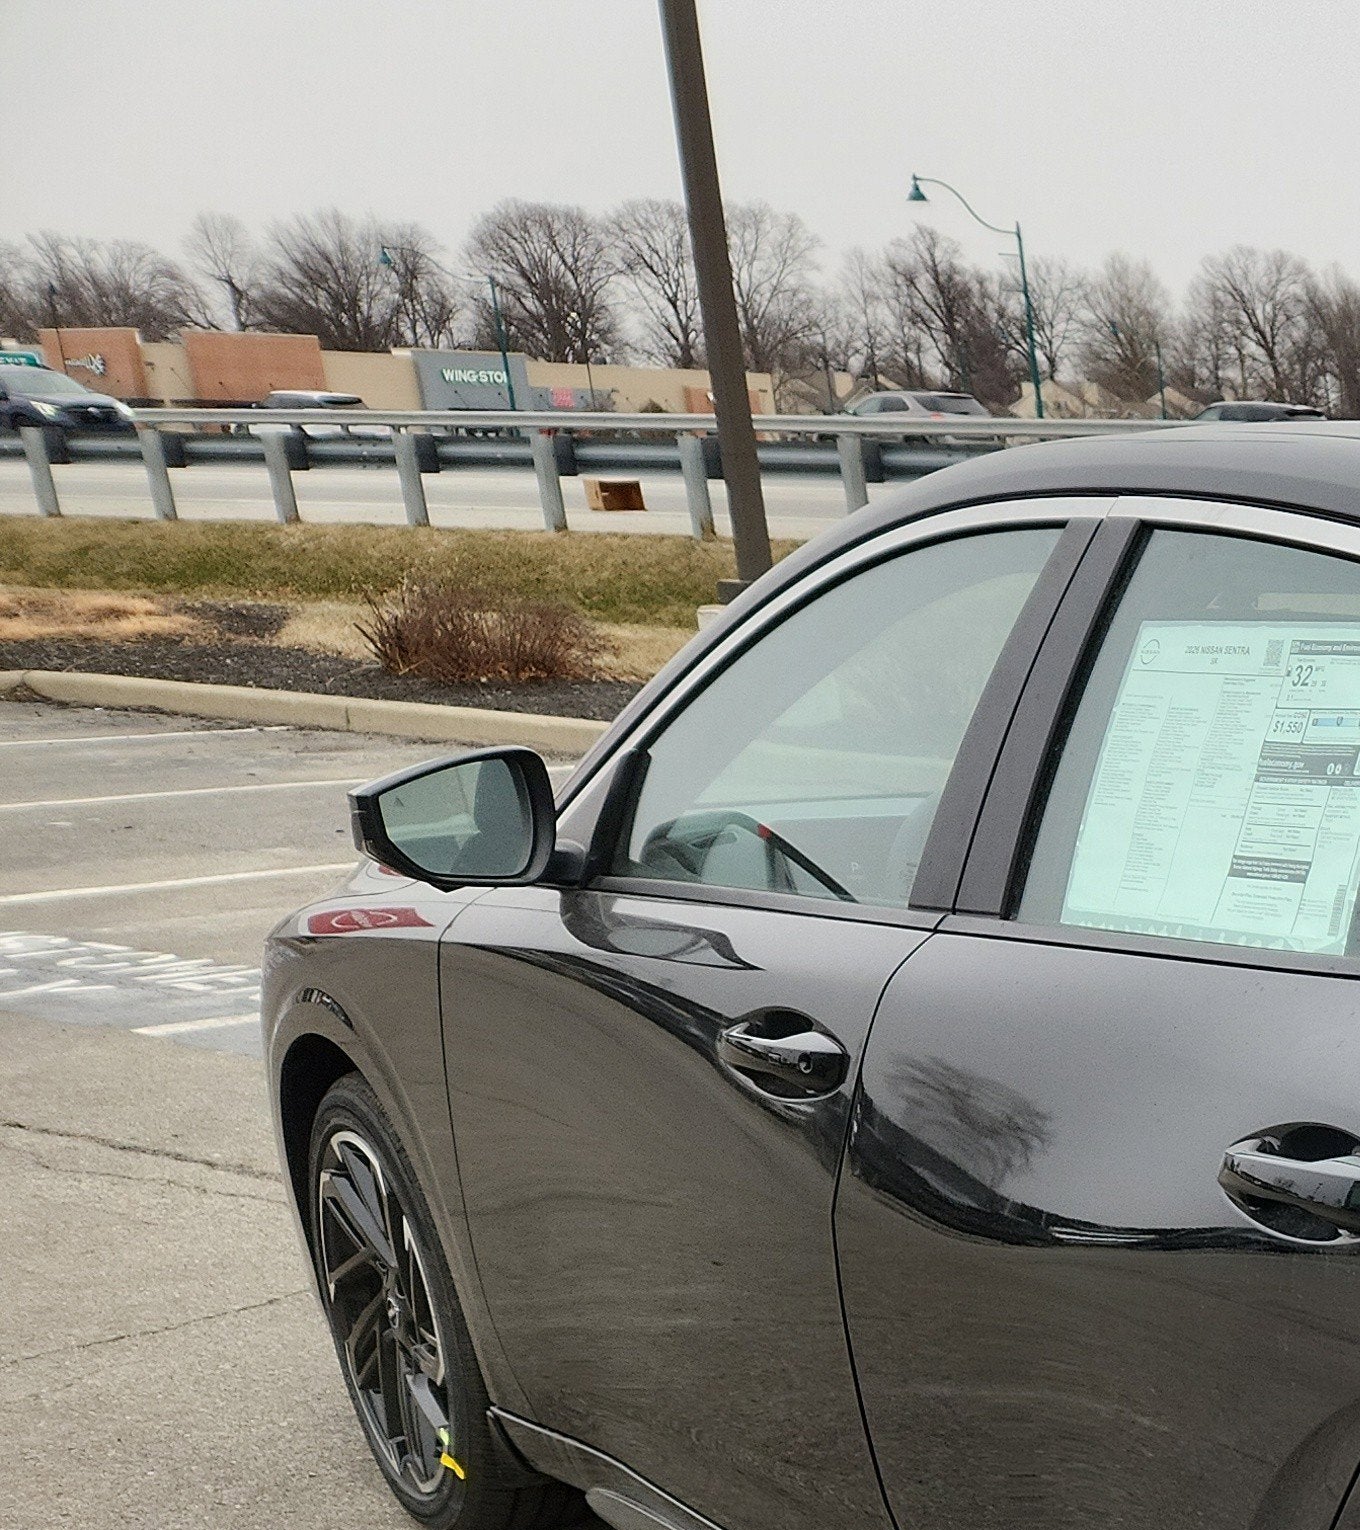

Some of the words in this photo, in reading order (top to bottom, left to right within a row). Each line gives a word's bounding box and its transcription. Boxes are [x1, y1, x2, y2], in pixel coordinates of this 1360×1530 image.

[1200, 646, 1223, 655] NISSAN
[1224, 646, 1251, 656] SENTRA
[1292, 664, 1313, 687] 32
